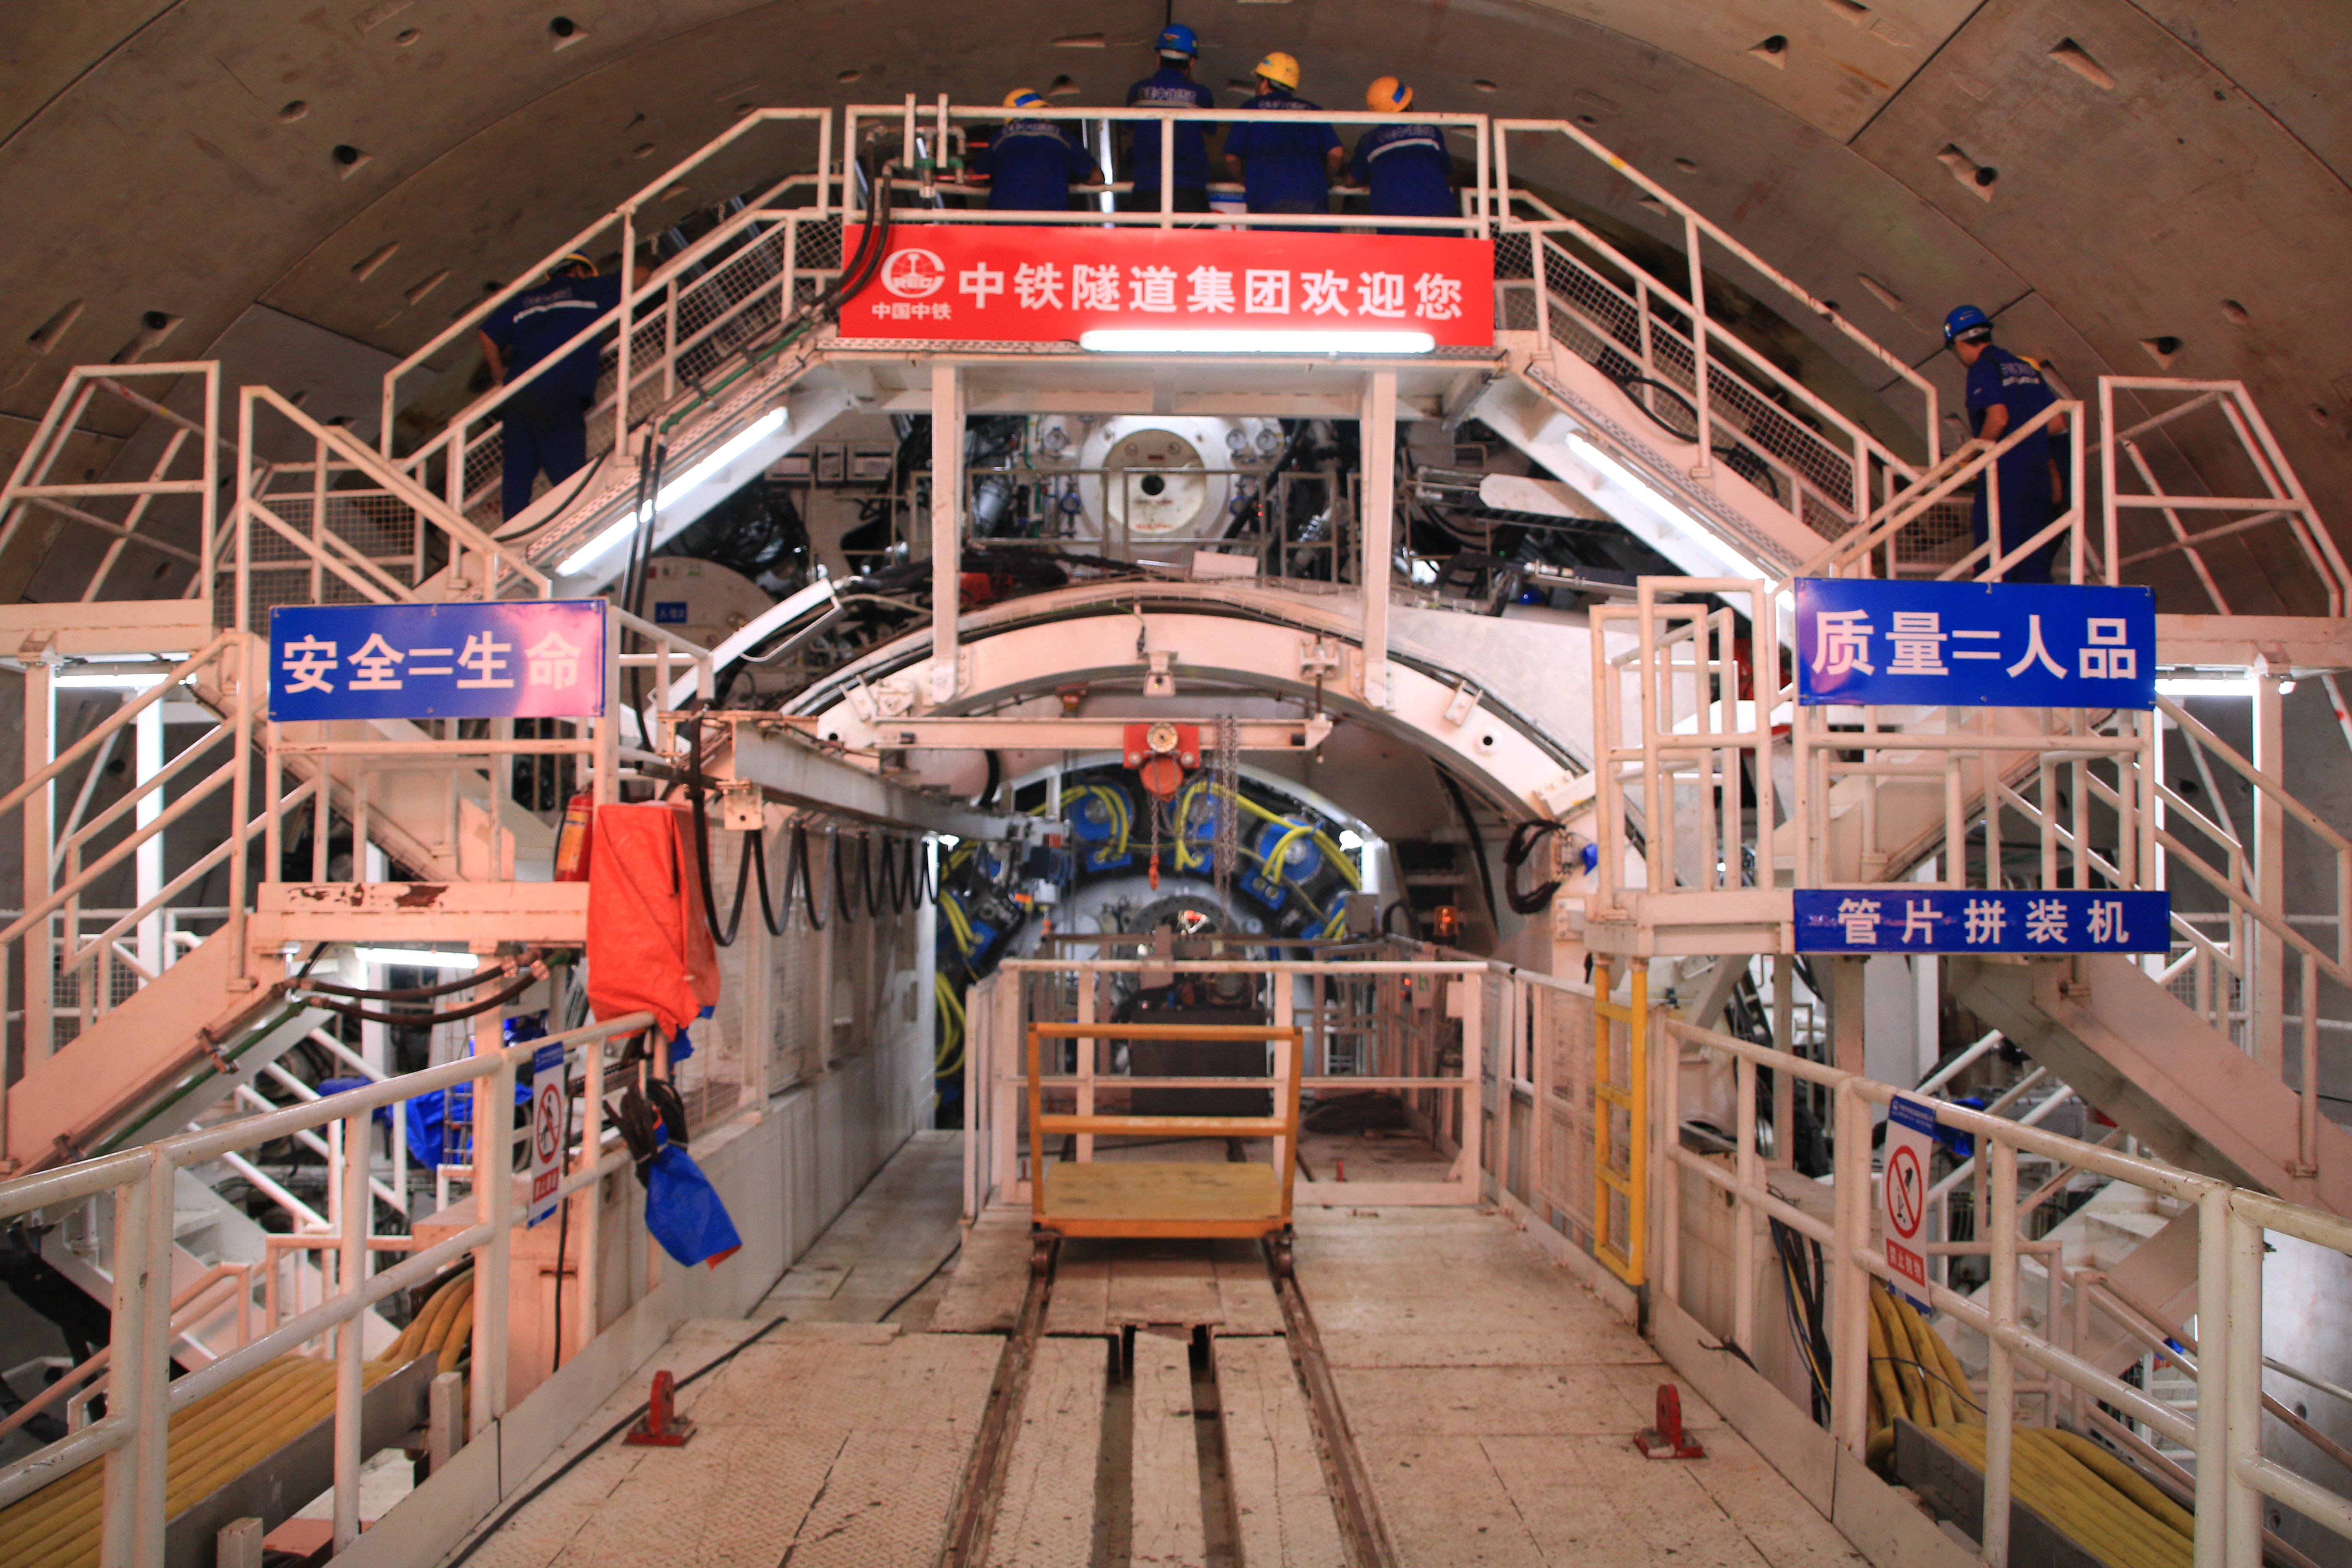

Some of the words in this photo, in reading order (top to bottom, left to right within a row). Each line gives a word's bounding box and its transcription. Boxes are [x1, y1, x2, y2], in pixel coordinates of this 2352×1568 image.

[871, 302, 952, 320] 中国中铁
[958, 261, 1462, 320] 中铁隧道集团欢迎您
[282, 631, 581, 694] 安全=生命
[1811, 609, 2137, 679] 质量=人品
[1838, 898, 2129, 944] 管片拼装机
